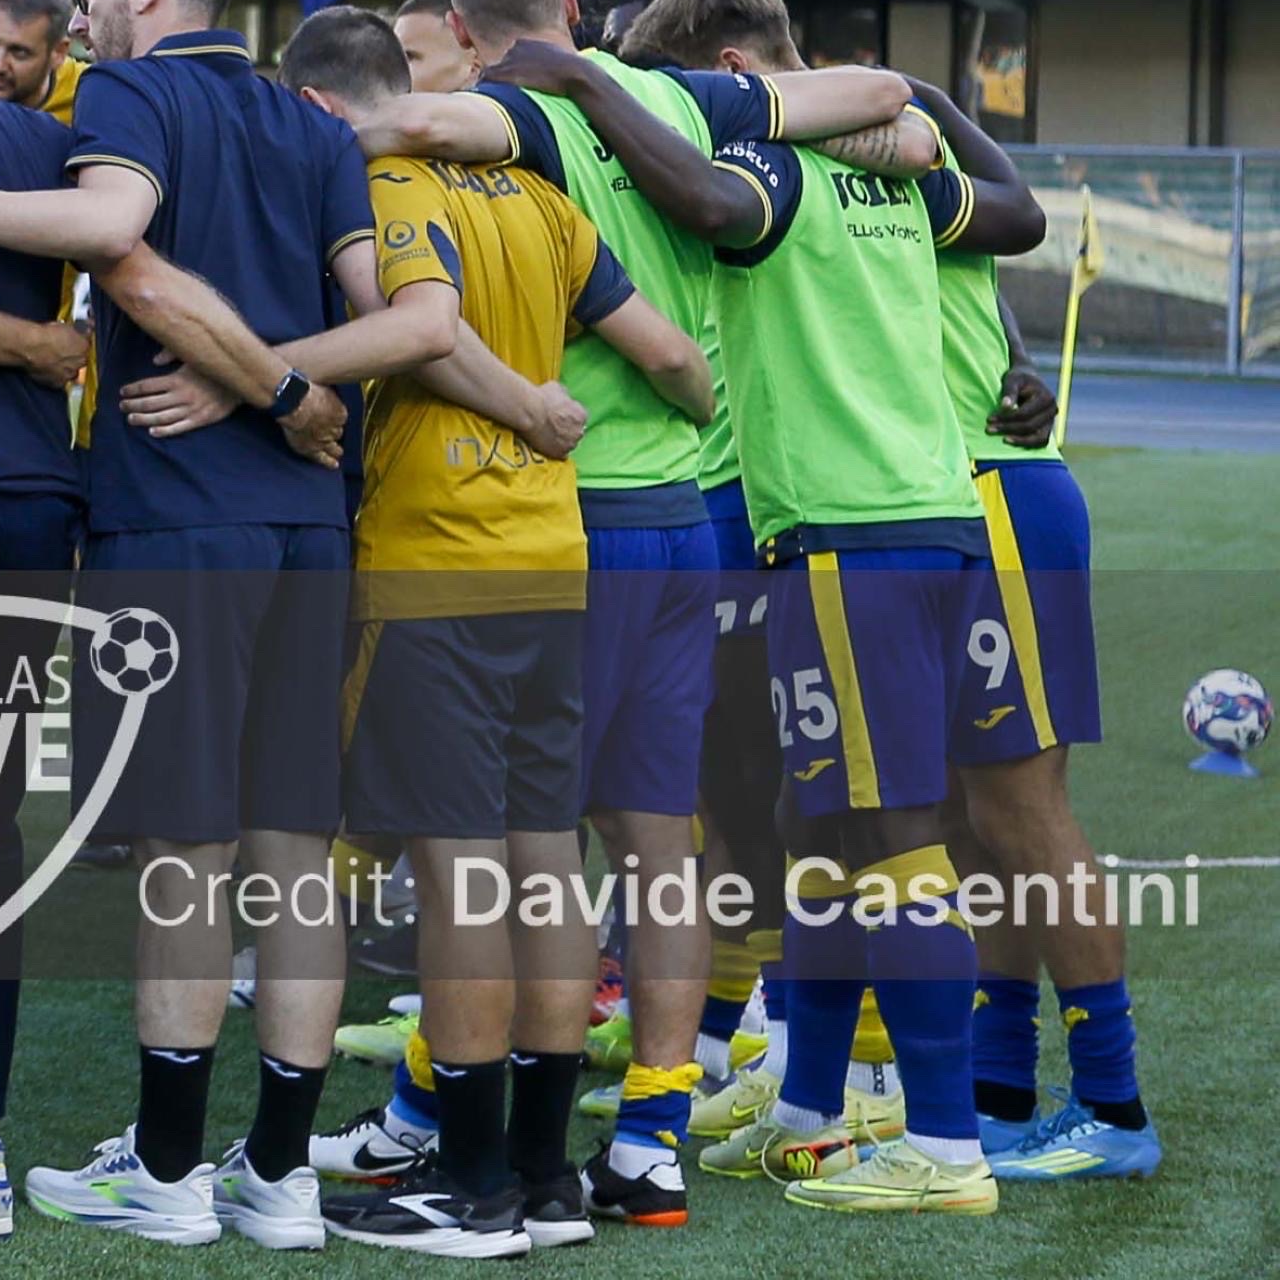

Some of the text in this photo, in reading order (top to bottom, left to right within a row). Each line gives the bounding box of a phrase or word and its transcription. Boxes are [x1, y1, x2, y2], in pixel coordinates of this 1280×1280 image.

[846, 222, 884, 240] ELLAS
[966, 618, 1012, 691] 9
[770, 668, 839, 748] 25
